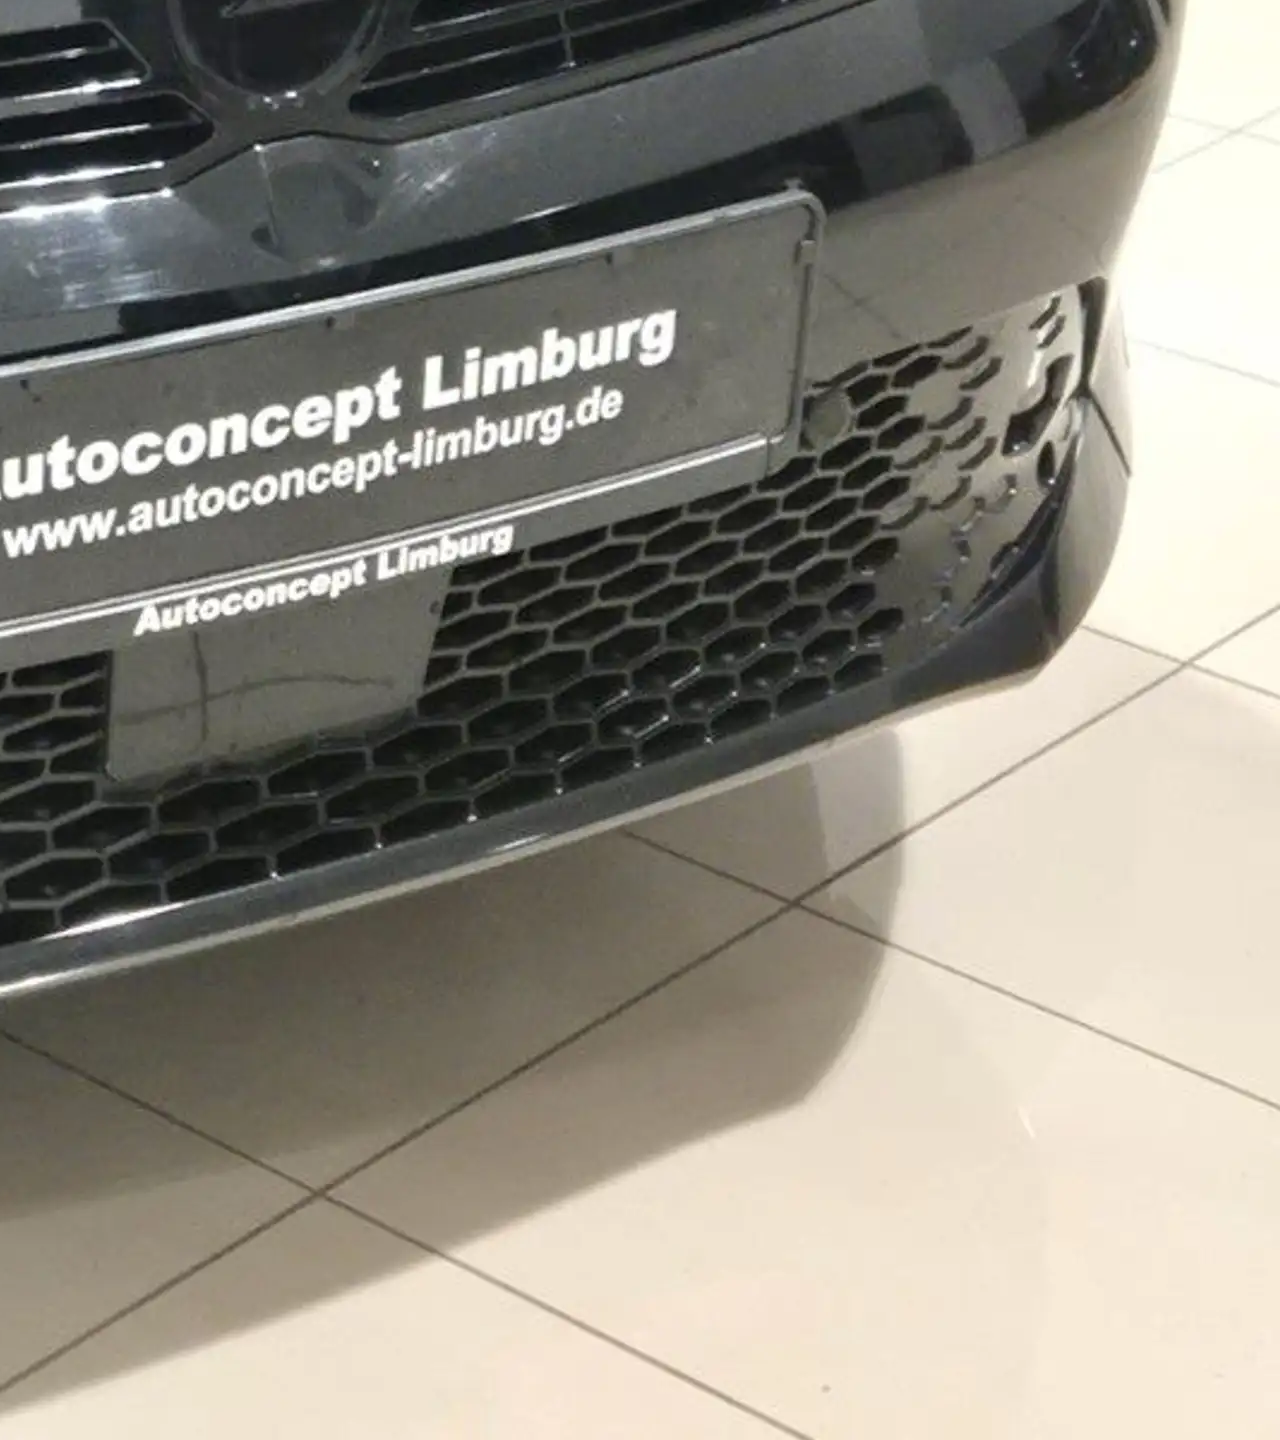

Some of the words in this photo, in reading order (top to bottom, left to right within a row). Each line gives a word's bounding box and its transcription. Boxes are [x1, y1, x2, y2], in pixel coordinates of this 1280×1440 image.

[421, 307, 678, 412] Limburg
[1, 384, 625, 559] www.autoconcept-limburg.de
[133, 563, 367, 636] Autoconcept
[376, 524, 515, 582] Limburg
